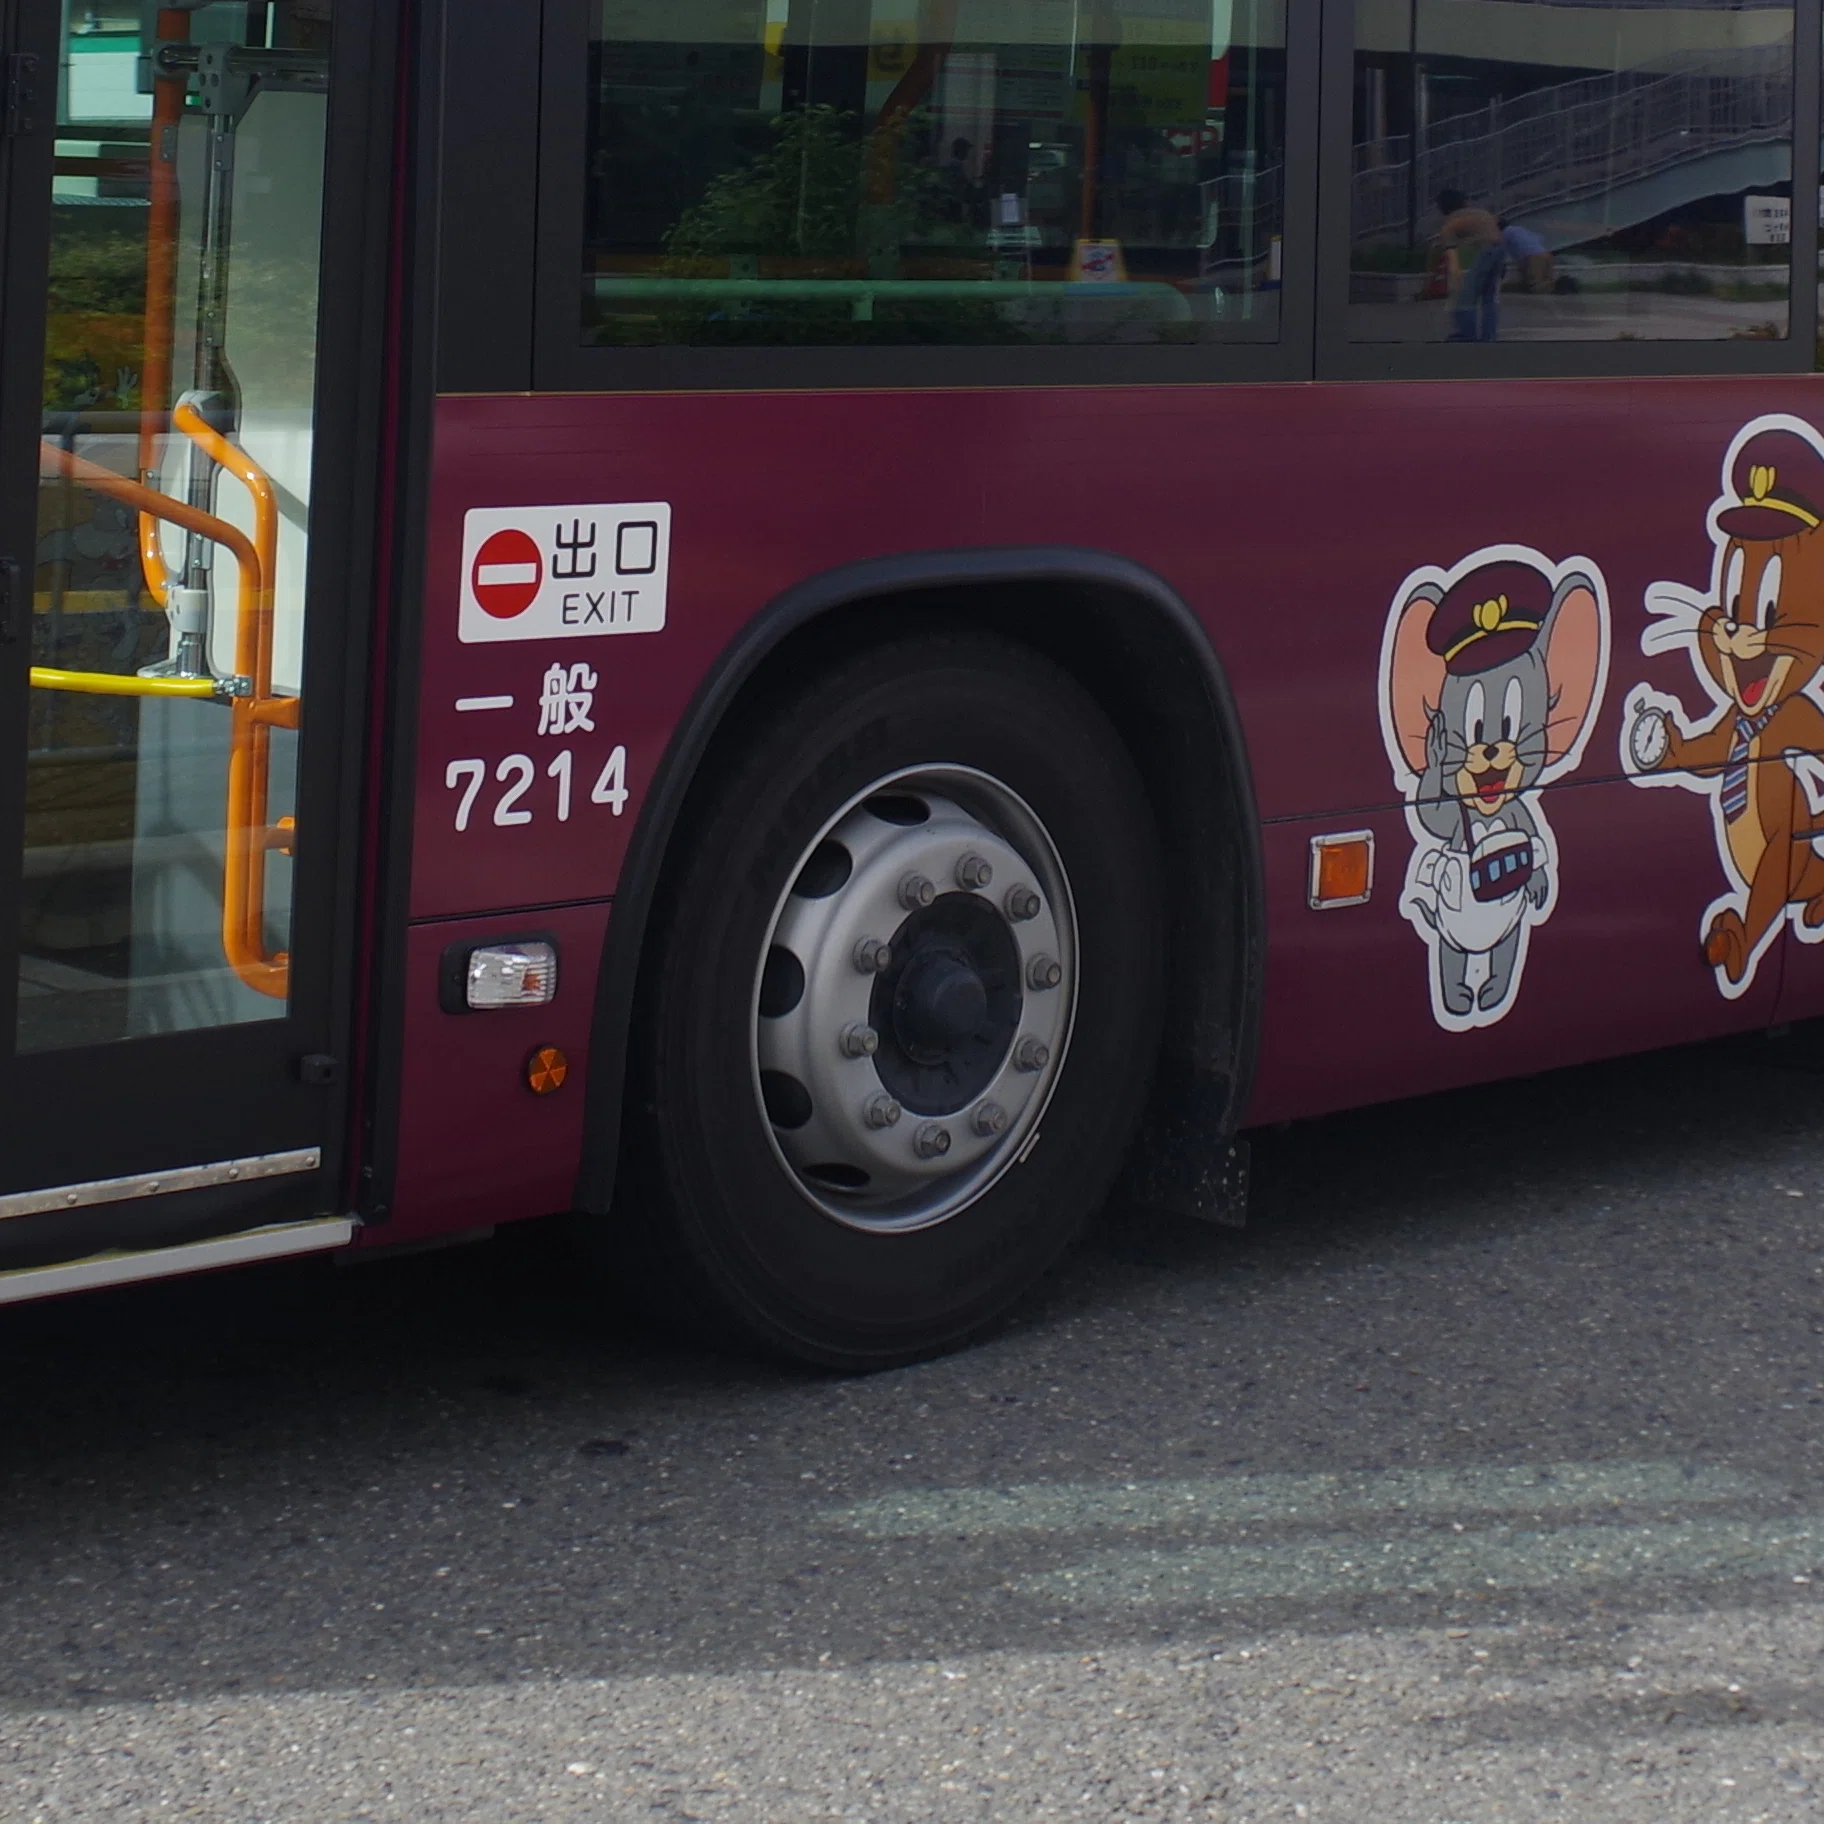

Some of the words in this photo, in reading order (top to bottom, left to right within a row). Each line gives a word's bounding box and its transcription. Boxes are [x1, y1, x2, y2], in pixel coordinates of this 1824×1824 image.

[552, 519, 658, 579] 出口
[561, 589, 640, 625] EXIT
[455, 662, 598, 736] 一般
[445, 745, 629, 832] 7214
